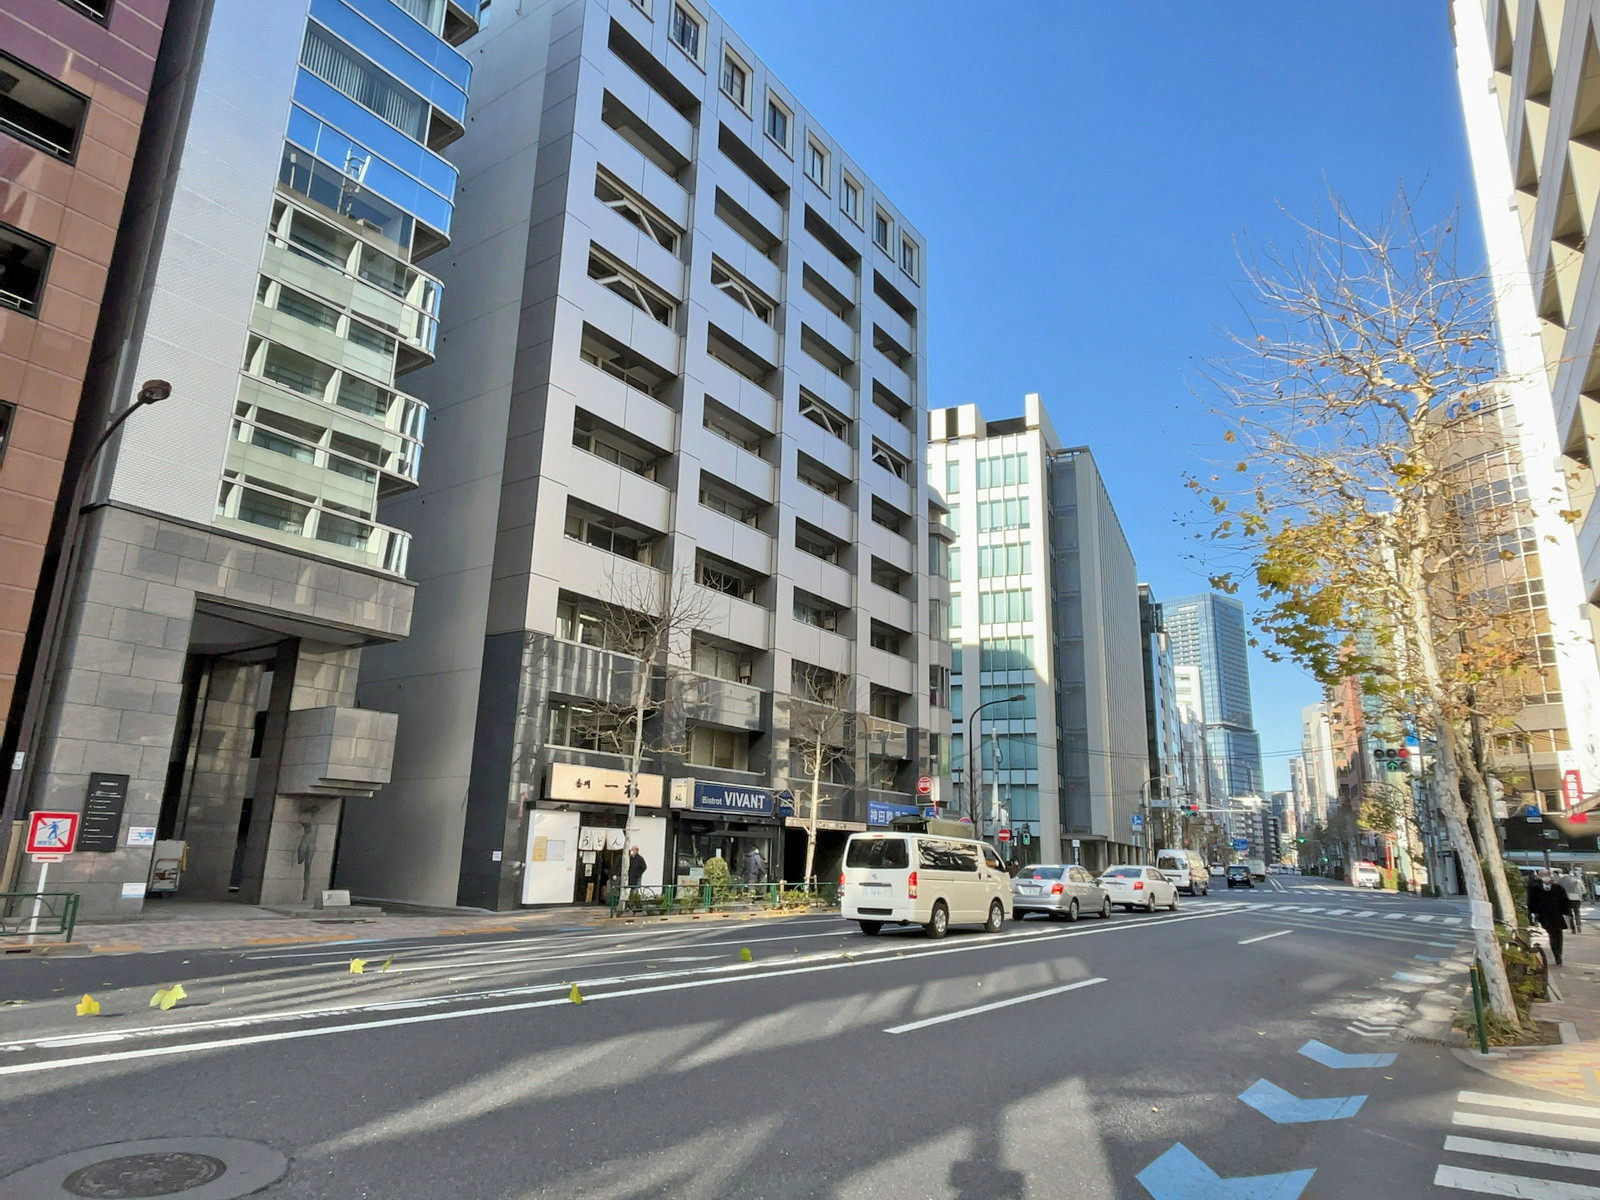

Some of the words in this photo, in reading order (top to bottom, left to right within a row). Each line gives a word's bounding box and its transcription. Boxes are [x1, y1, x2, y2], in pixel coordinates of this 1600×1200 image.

[701, 795, 723, 806] Bistrot
[724, 790, 766, 810] VIVANT
[870, 808, 909, 824] 神田整
[582, 836, 621, 847] うどん
